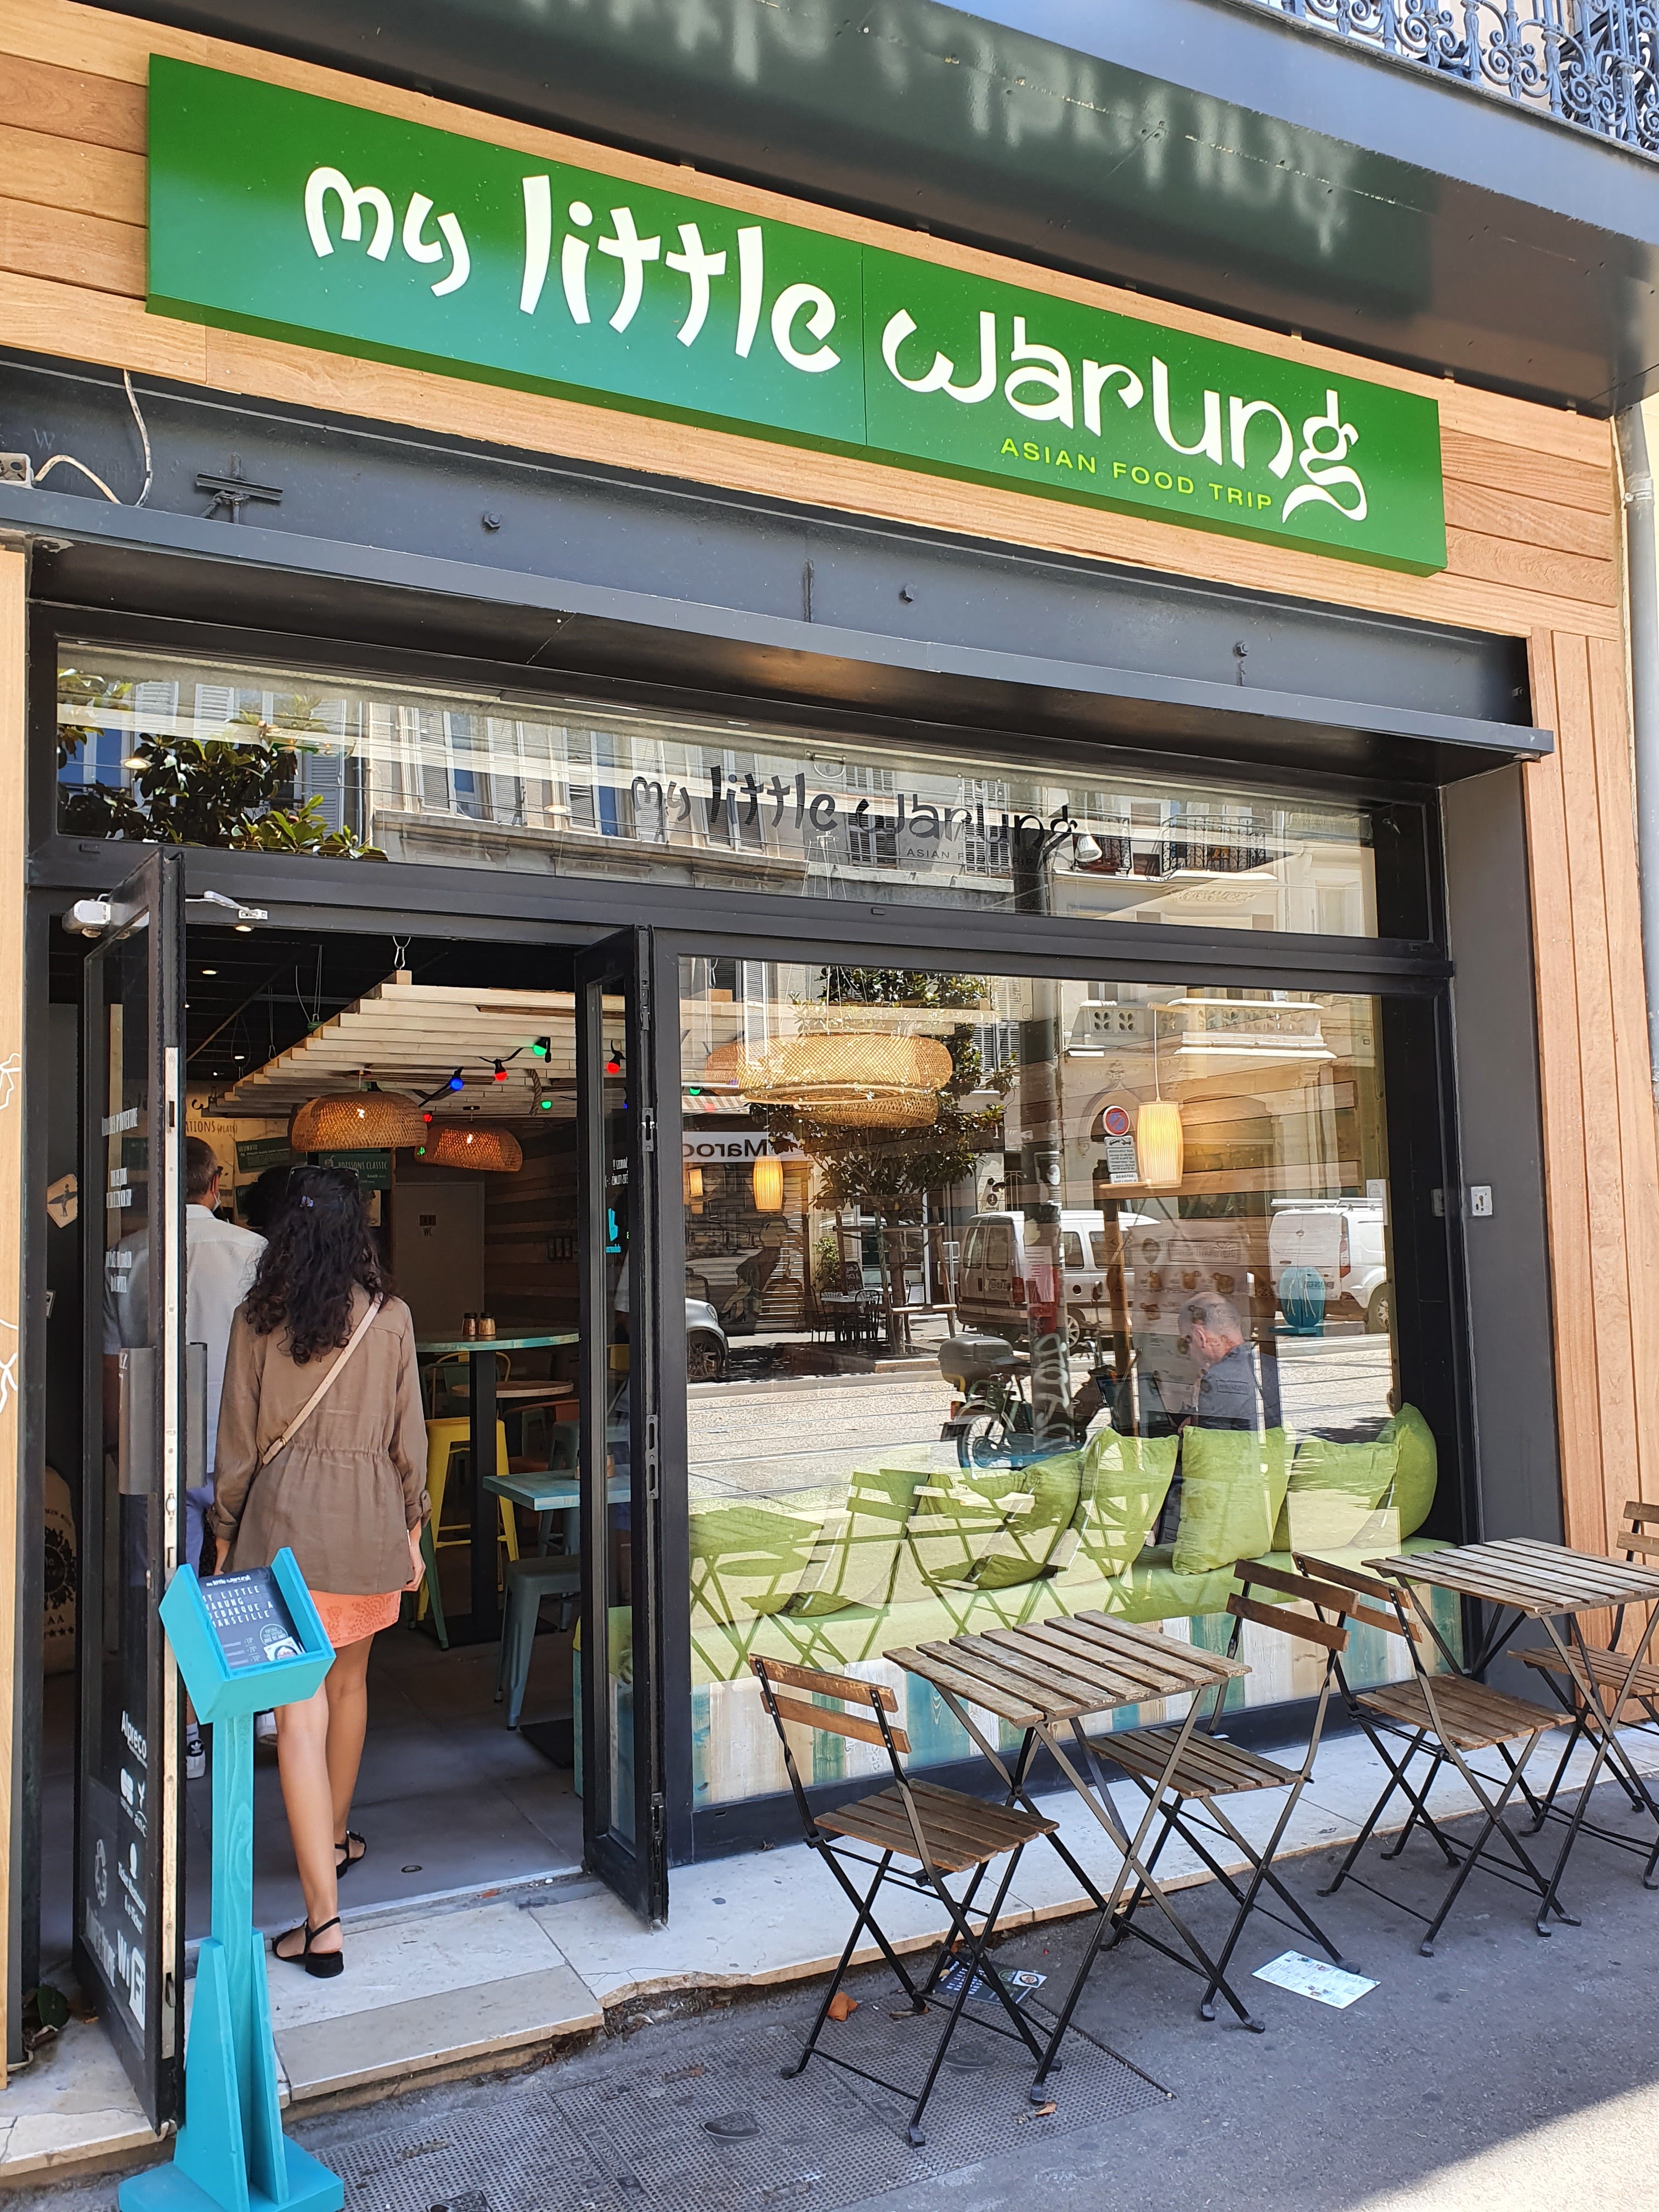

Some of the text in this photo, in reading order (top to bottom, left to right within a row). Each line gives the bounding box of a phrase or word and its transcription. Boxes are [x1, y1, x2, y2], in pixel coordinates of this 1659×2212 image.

[304, 166, 1368, 523] my little warung
[1000, 438, 1272, 510] ASIAN FOOD TRIP
[631, 776, 691, 822] my
[710, 765, 838, 832] little
[906, 848, 950, 858] ASIAN
[366, 1161, 387, 1169] CLASSIC
[423, 1226, 432, 1237] WC
[221, 1585, 259, 1599] LITTLE
[268, 1601, 274, 1610] A
[121, 1710, 146, 1759] Alpreco
